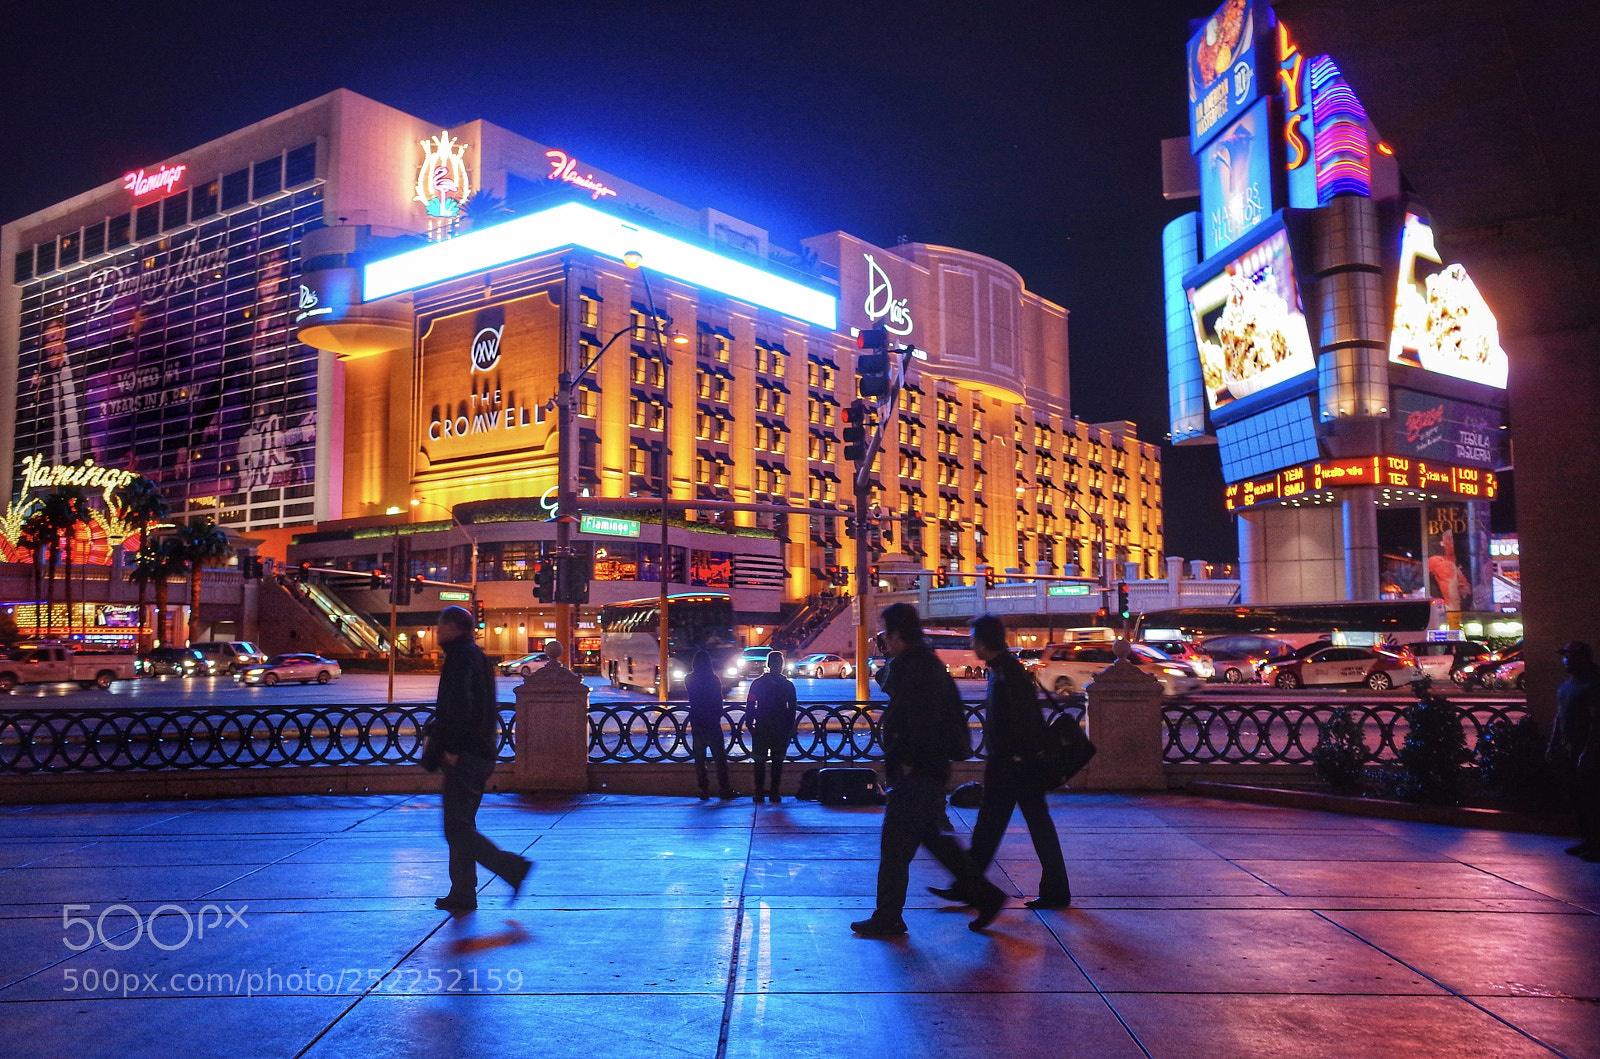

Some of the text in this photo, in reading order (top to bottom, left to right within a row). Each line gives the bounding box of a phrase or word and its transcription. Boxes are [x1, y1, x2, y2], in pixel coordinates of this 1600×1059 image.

[124, 164, 187, 197] Flamingo
[545, 149, 617, 200] Flamingo
[109, 395, 141, 415] YEARS
[145, 391, 157, 407] IN
[160, 390, 168, 407] A
[470, 390, 501, 408] THE
[428, 403, 546, 442] CROMWELL
[1284, 467, 1303, 482] TEM
[1314, 463, 1321, 476] 0
[1387, 457, 1426, 474] TCU 3
[1459, 468, 1477, 481] LOU
[21, 452, 140, 502] Flamingo
[1388, 473, 1426, 488] TEX 7
[1284, 477, 1322, 497] SMU 0
[1459, 483, 1494, 498] FSU 9
[586, 517, 629, 535] Flamingo
